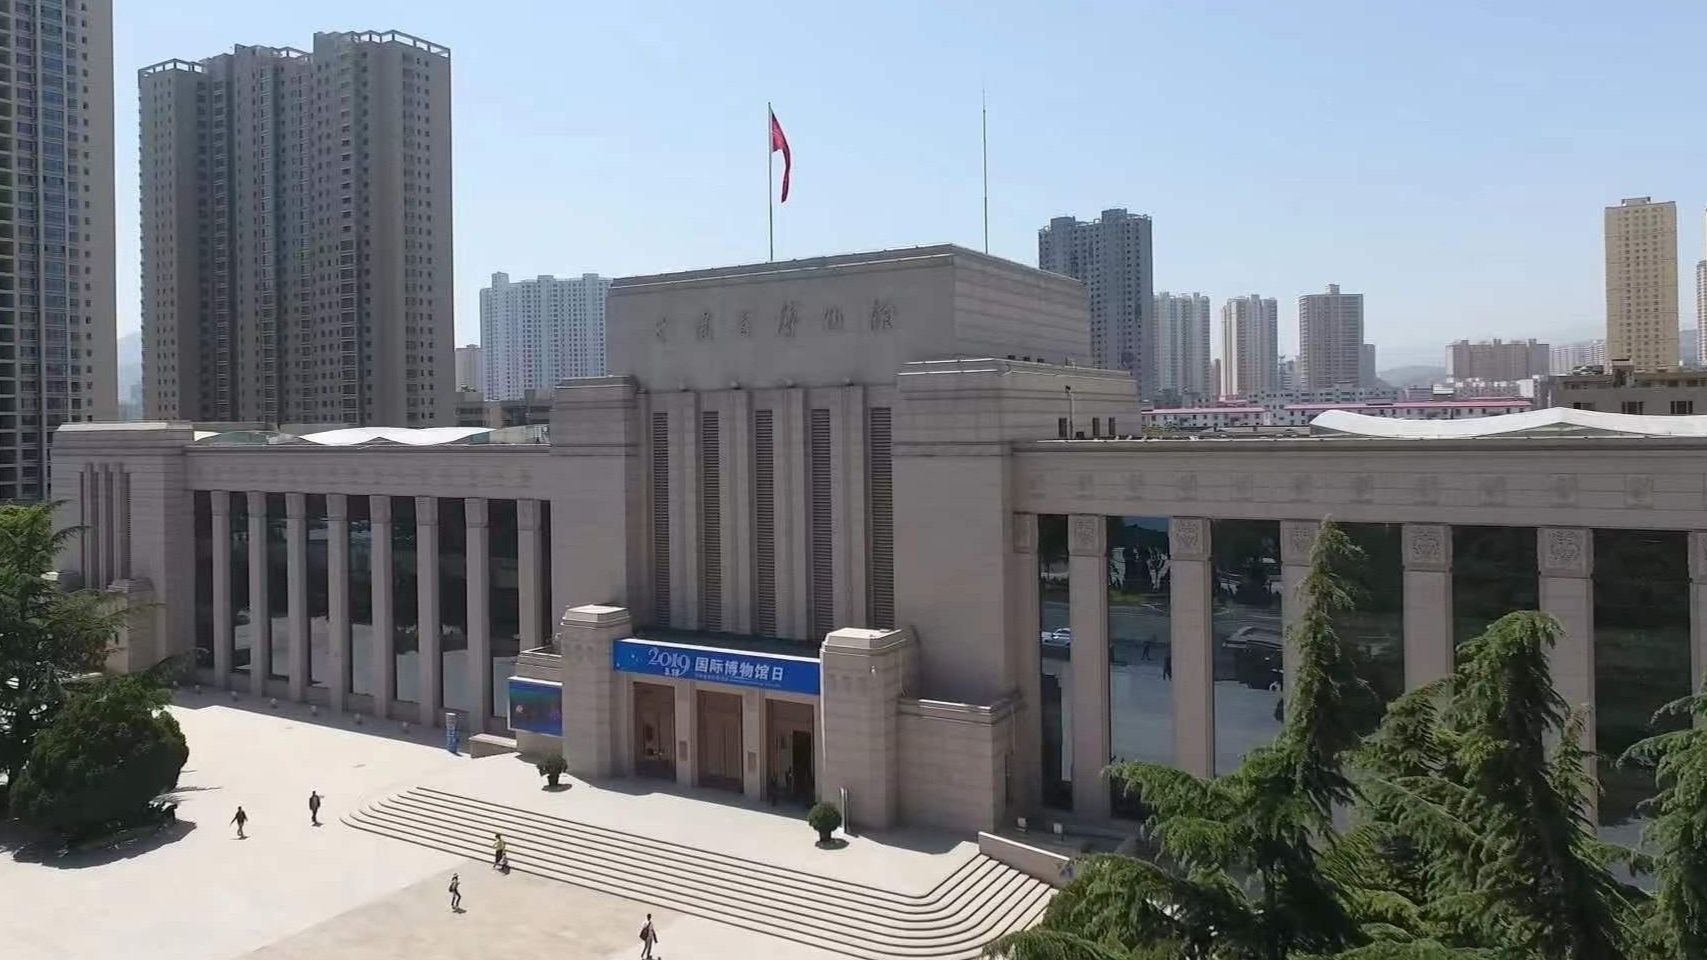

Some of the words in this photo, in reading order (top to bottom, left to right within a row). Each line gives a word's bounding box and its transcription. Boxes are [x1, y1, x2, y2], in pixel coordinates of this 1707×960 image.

[648, 647, 690, 677] 2019
[695, 656, 784, 681] 国际博物馆日
